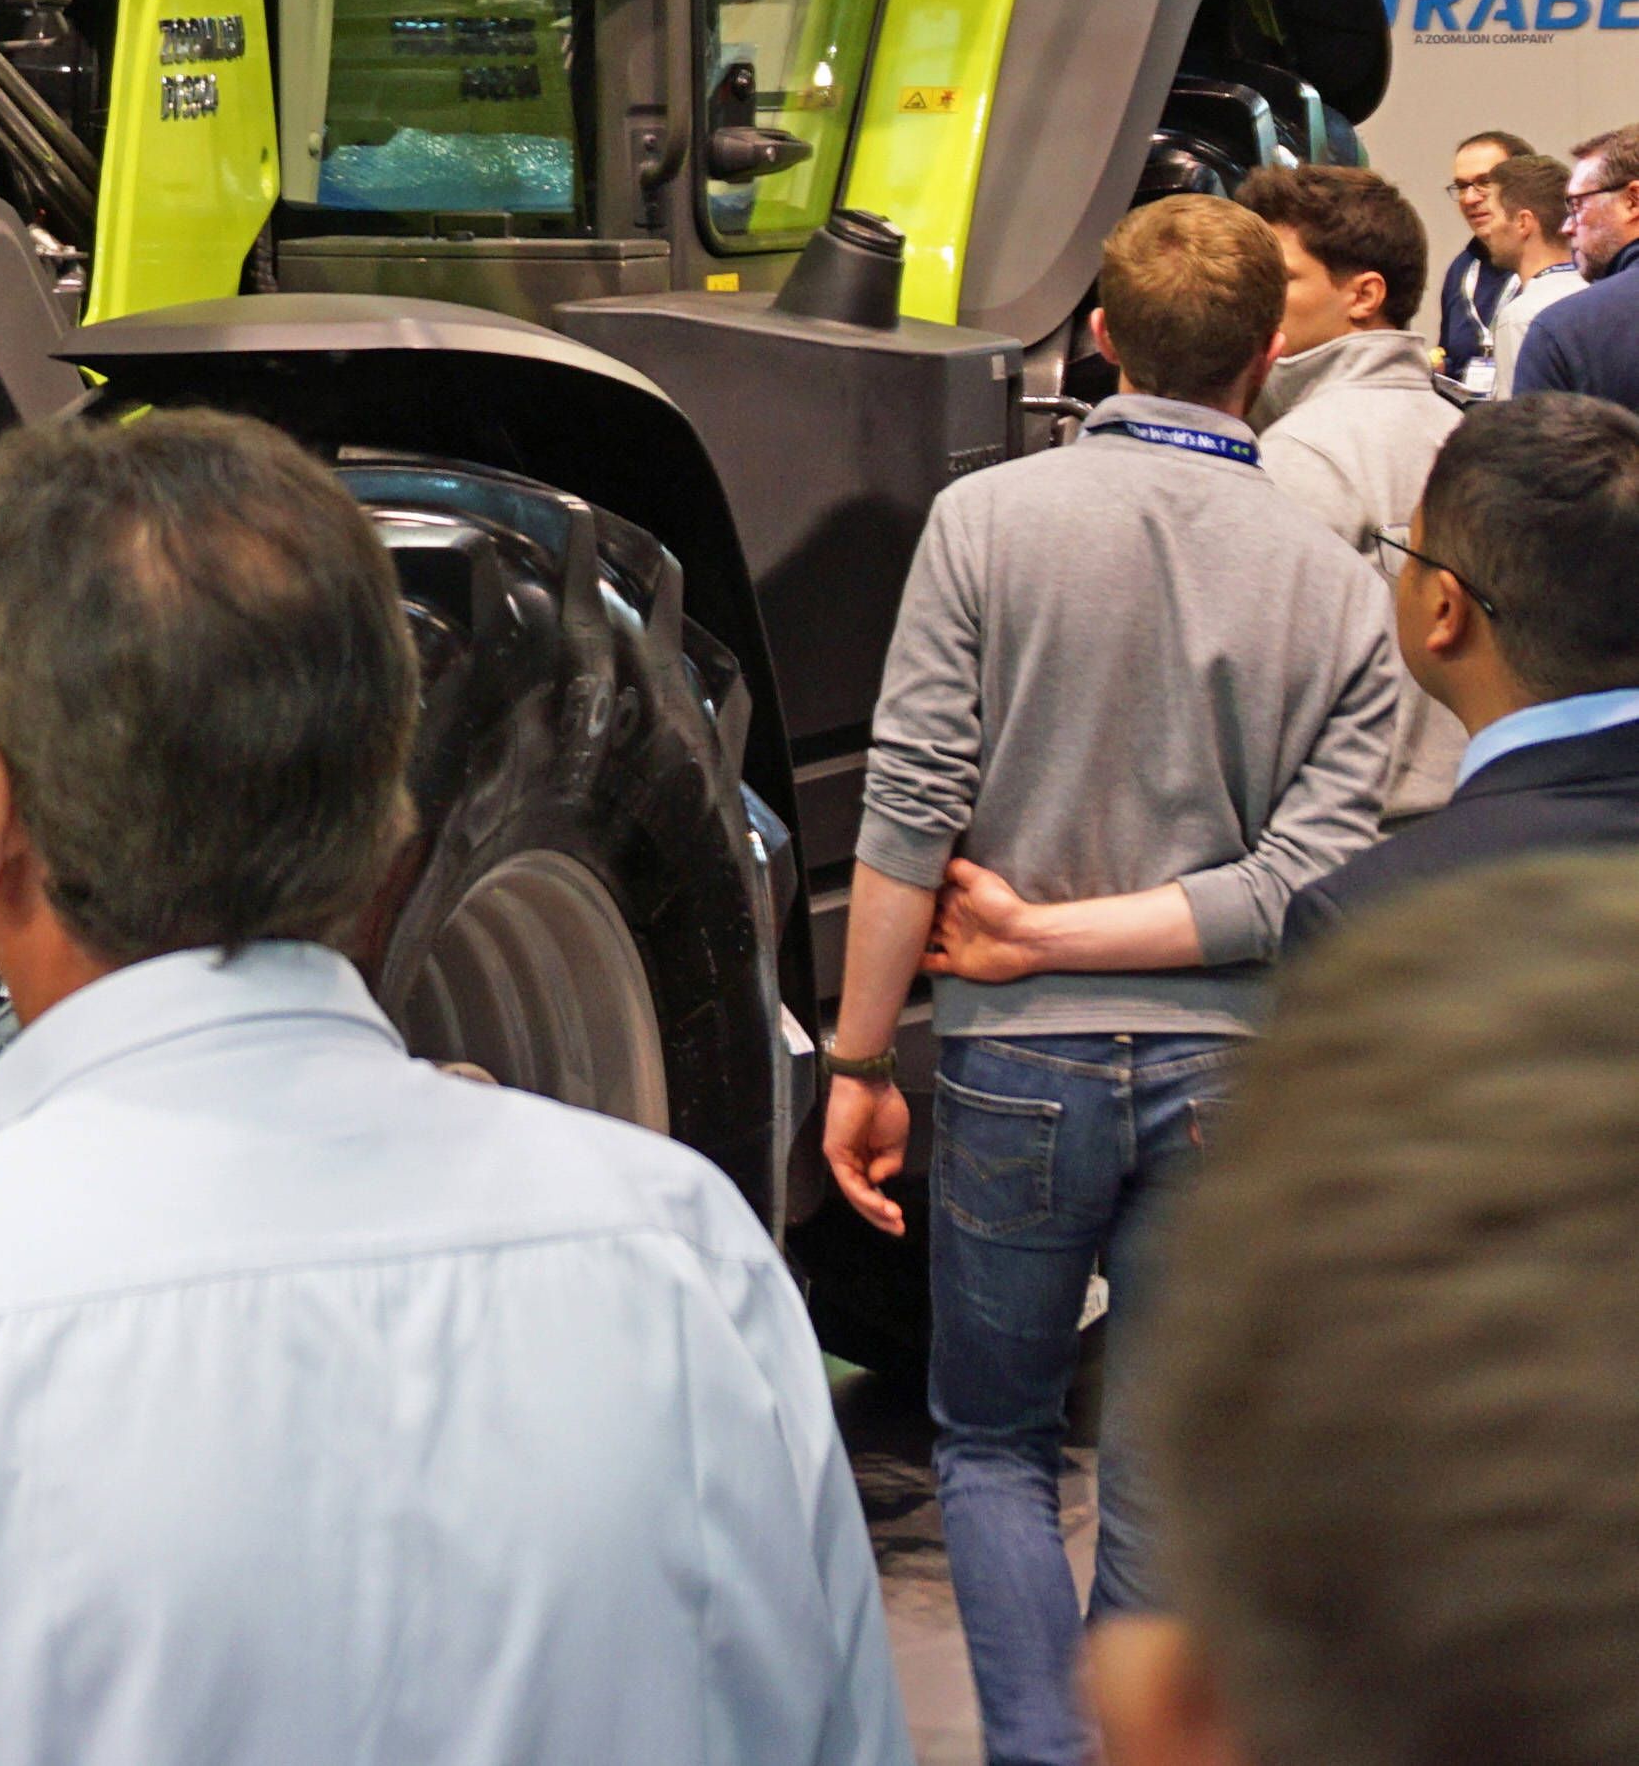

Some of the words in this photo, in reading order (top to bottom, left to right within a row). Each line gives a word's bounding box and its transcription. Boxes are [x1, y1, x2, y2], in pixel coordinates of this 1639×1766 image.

[1414, 34, 1423, 44] A
[1425, 34, 1490, 44] ZOOMLION
[1493, 34, 1554, 44] COMPANY
[1150, 428, 1196, 445] World's
